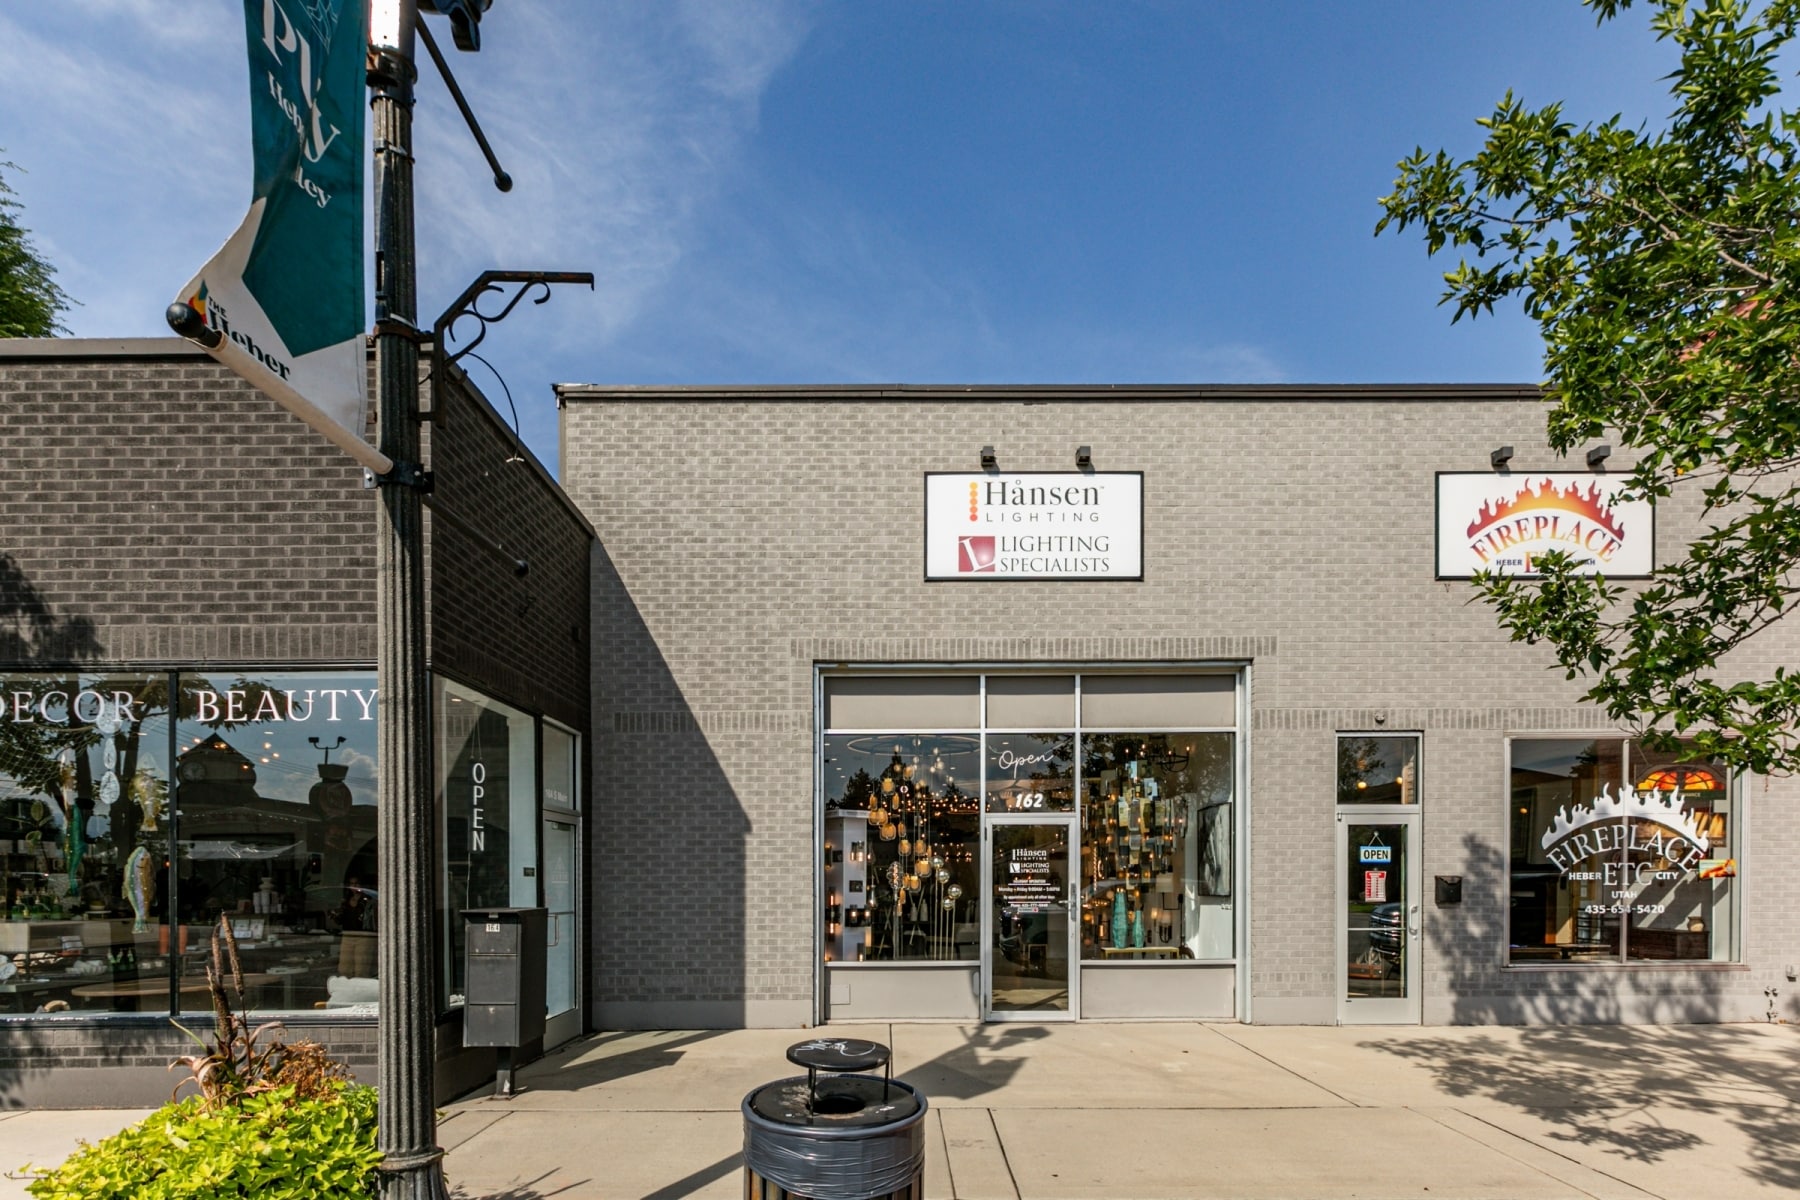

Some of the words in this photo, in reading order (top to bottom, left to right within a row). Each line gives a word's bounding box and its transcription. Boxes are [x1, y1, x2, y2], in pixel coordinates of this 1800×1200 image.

[208, 295, 227, 318] THE
[986, 512, 1100, 522] LIGHTING
[1001, 536, 1110, 552] LIGHTING
[1470, 515, 1622, 564] FIREPLACE
[1000, 557, 1110, 572] SPECIALISTS
[0, 690, 140, 723] ECOR
[195, 689, 379, 722] BEAUTY
[998, 750, 1054, 780] Open
[472, 762, 485, 852] OPEN
[1015, 793, 1043, 808] 162
[1363, 849, 1389, 860] OPEN
[1546, 824, 1704, 874] FIREPLACE
[1568, 872, 1602, 880] HEBER
[1655, 871, 1679, 880] CITY
[1603, 862, 1652, 886] ETC
[1611, 891, 1637, 899] UTAH
[1585, 904, 1665, 914] 435-654-5420
